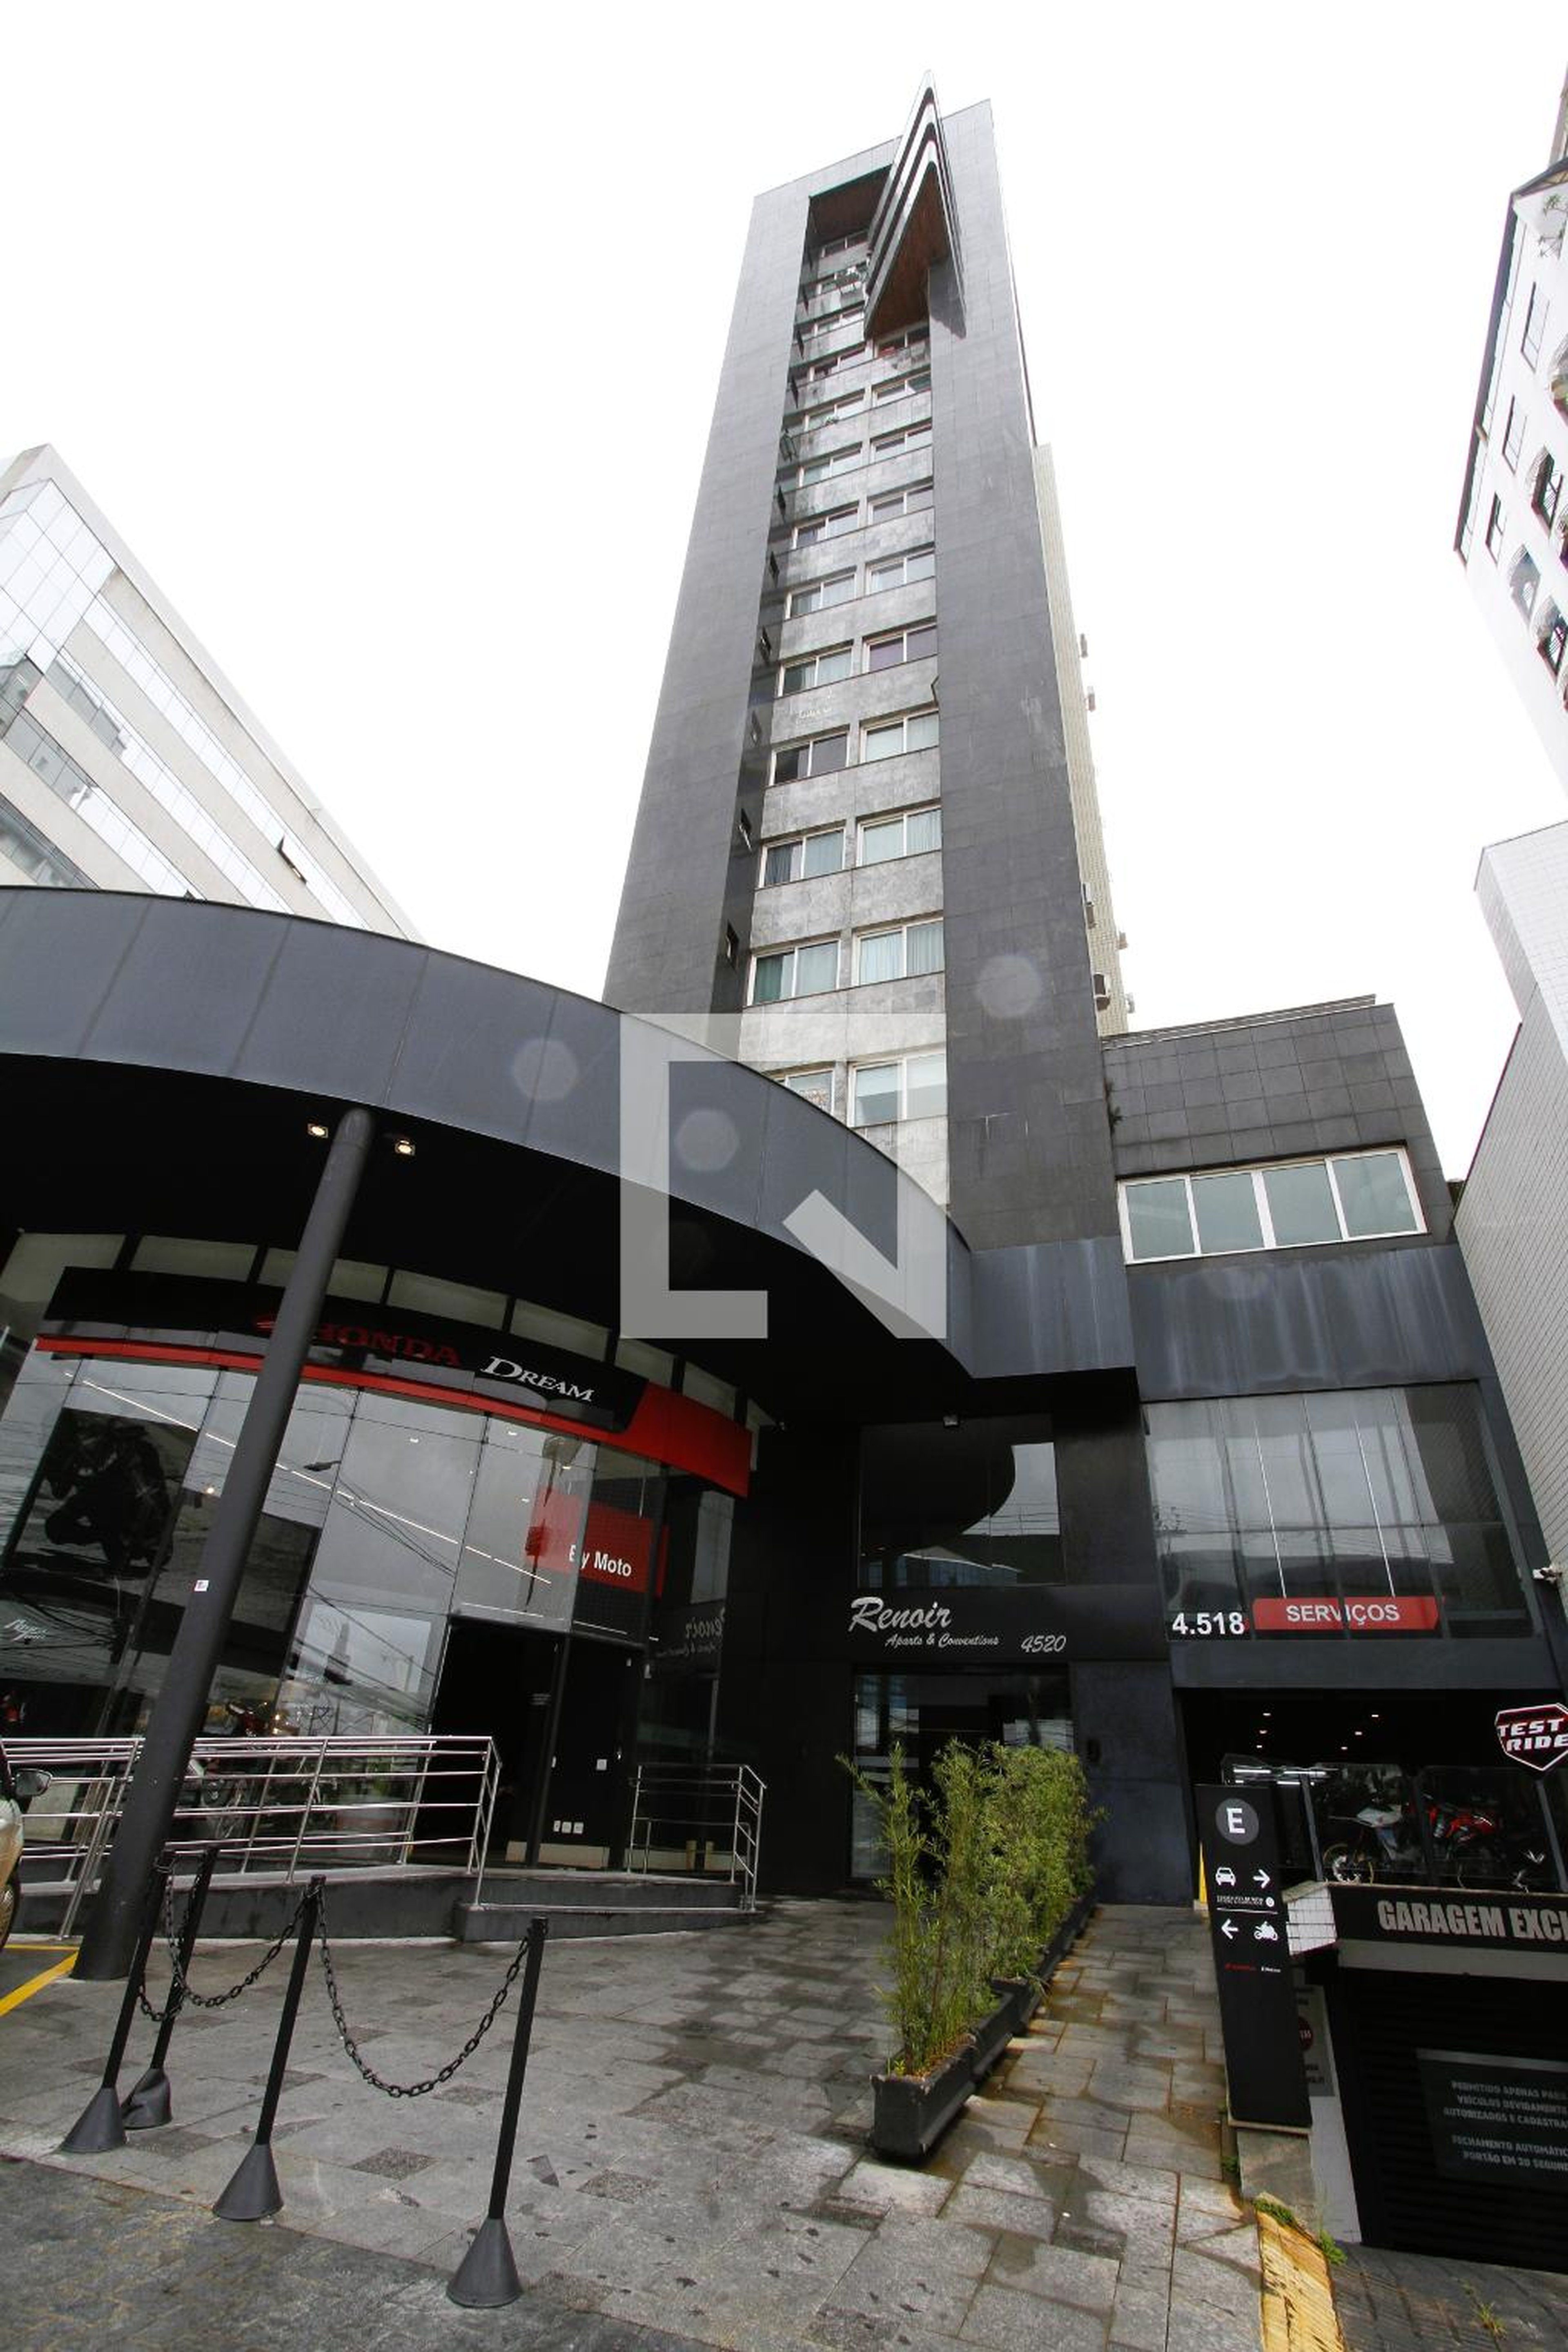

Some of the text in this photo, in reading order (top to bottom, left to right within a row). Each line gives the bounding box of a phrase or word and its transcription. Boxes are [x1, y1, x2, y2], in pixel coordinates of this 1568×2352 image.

[480, 1356, 595, 1402] DREAM
[593, 1551, 632, 1577] Moto
[848, 1597, 951, 1631] Renoir
[1172, 1612, 1245, 1634] 4.518
[1286, 1604, 1400, 1625] SERVIÇOS
[885, 1633, 999, 1648] Aparts & Conventions
[1021, 1635, 1066, 1653] 4520
[1497, 1718, 1564, 1737] TEST
[1506, 1734, 1568, 1751] RIDE
[1227, 1808, 1245, 1834] E
[1377, 1900, 1506, 1937] GARAGEM
